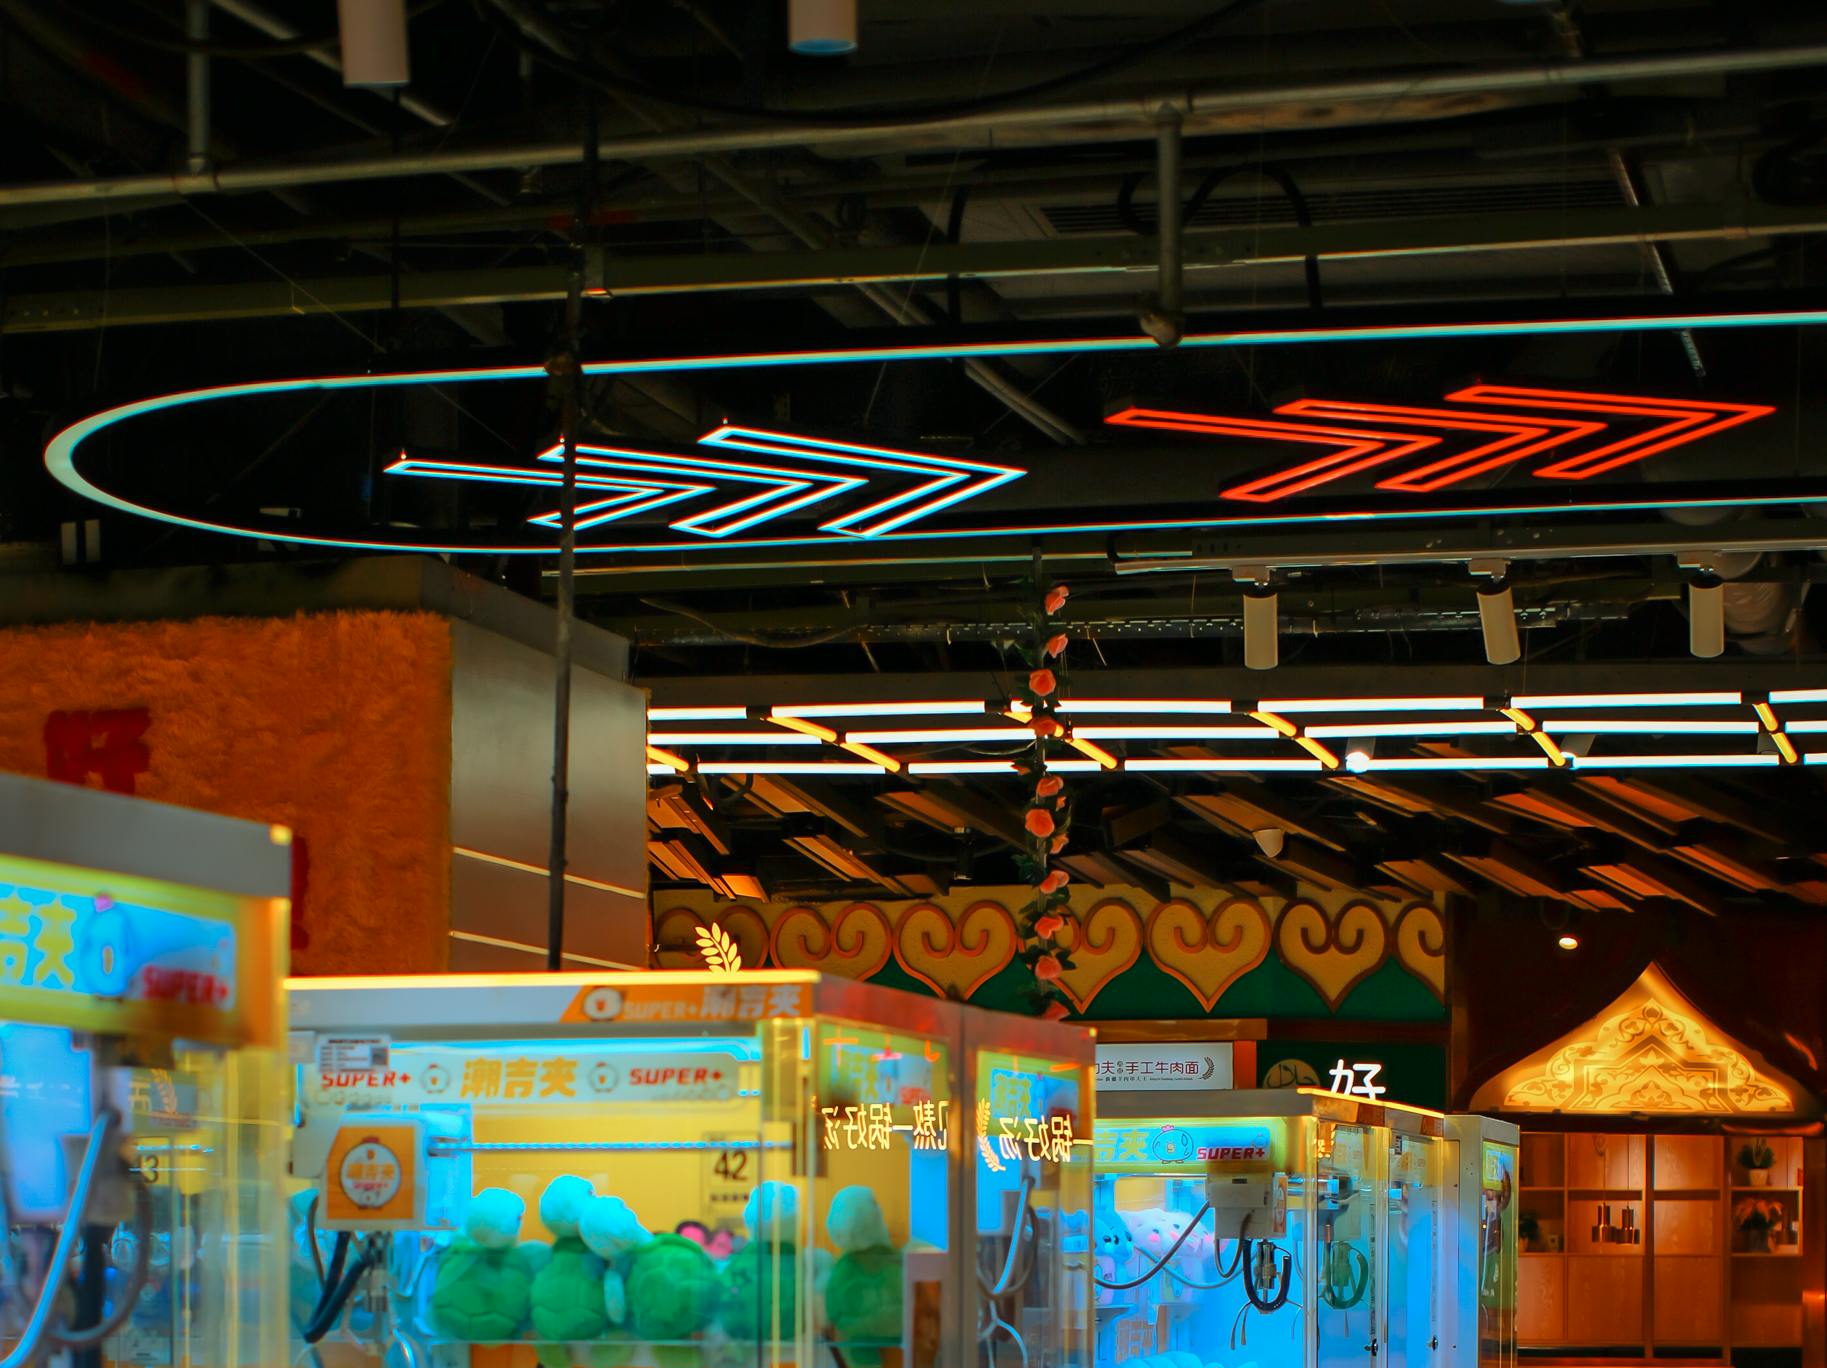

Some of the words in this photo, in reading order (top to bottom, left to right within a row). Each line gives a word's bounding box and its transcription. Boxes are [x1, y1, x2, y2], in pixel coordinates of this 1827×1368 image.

[460, 1056, 578, 1098] 潮吉夹
[629, 1067, 722, 1086] SUPER+
[1328, 1058, 1387, 1101] 好
[713, 1149, 749, 1181] 42
[1196, 1146, 1266, 1160] SUPER+
